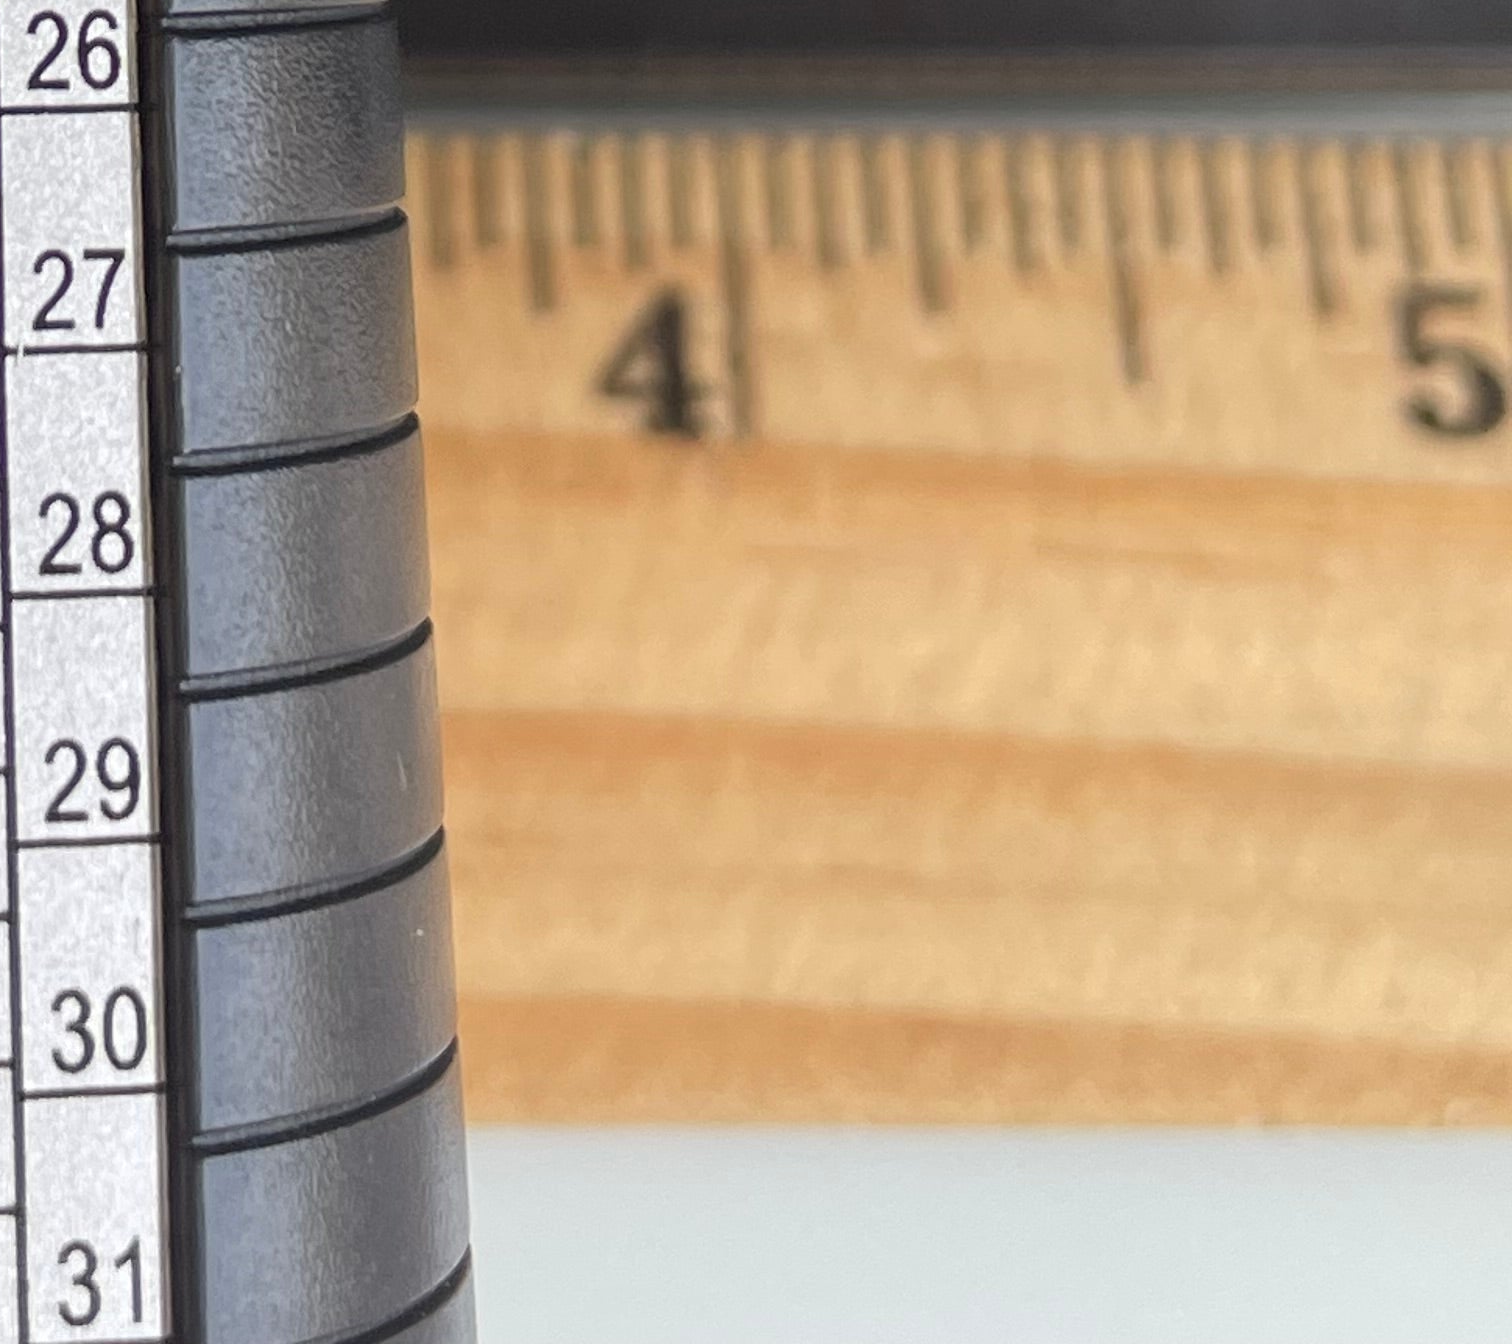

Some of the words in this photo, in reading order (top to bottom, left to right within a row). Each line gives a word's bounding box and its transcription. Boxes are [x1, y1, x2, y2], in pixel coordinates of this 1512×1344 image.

[26, 9, 122, 91] 26
[31, 248, 126, 332] 27
[593, 282, 710, 440] 4
[1393, 279, 1509, 439] 5
[38, 490, 135, 576] 28
[44, 737, 141, 824] 29
[52, 986, 148, 1075] 30
[55, 1234, 144, 1328] 31
